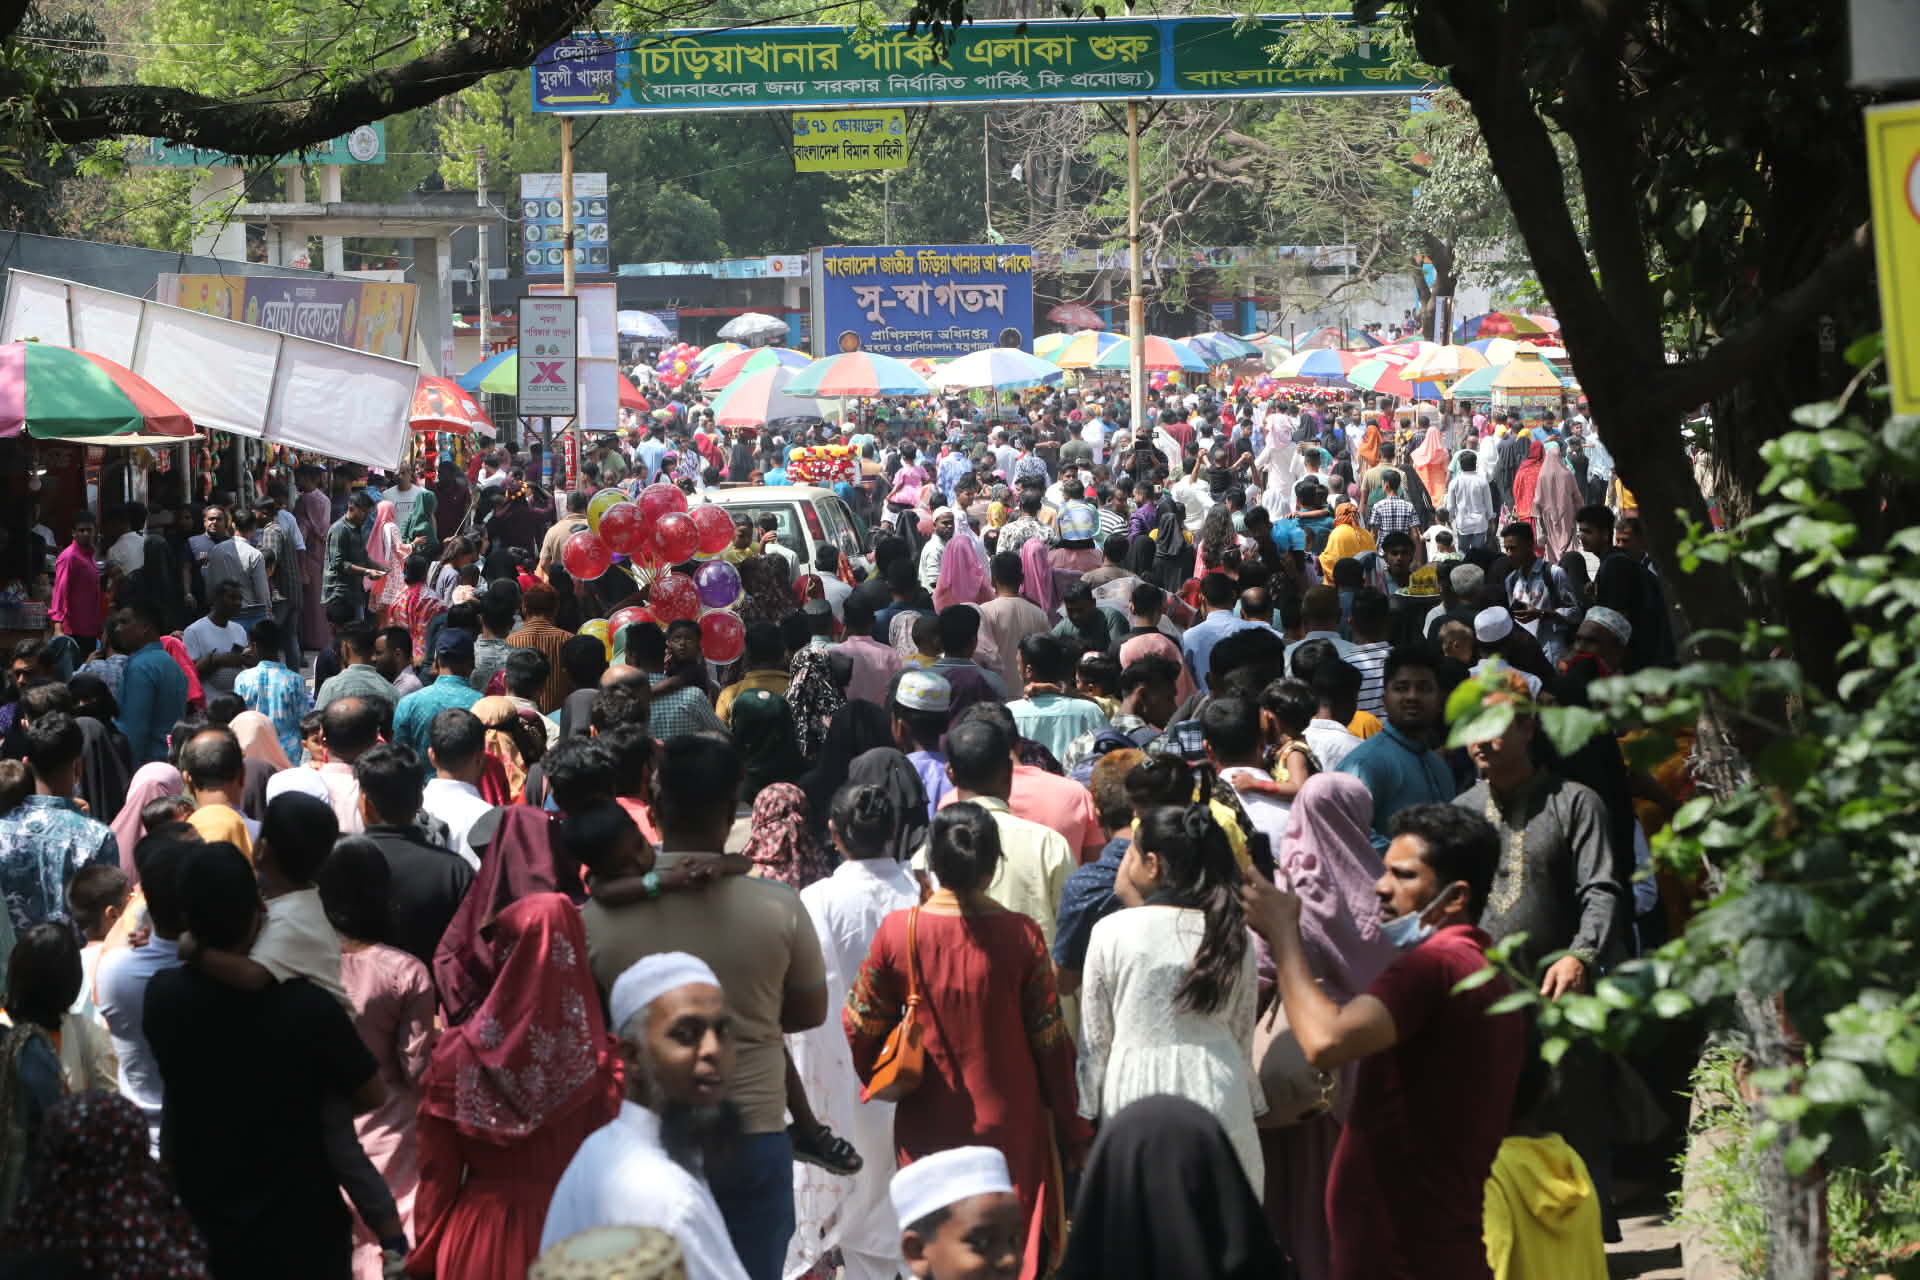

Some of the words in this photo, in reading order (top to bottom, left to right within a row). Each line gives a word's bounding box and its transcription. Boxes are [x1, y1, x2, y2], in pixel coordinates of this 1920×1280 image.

[636, 36, 842, 80] চিড়িয়াখানার
[854, 31, 954, 70] পার্কিং
[965, 35, 1079, 68] এলাকা
[1088, 35, 1153, 64] শুরু
[538, 65, 573, 92] মুরগী
[765, 79, 806, 96] জন্য
[813, 78, 881, 95] সরকার
[889, 72, 966, 93] নির্ধারিত
[974, 70, 1033, 90] পার্কিং
[1038, 70, 1067, 89] ফি
[1183, 65, 1351, 86] বাংলাদেশ
[812, 120, 828, 133] ৭১
[793, 144, 839, 160] বাংলাদেশ
[843, 139, 870, 160] বিমান
[873, 138, 904, 160] বাহিনী
[824, 253, 877, 278] বাংলাদেশ
[879, 250, 914, 277] জাতীয়
